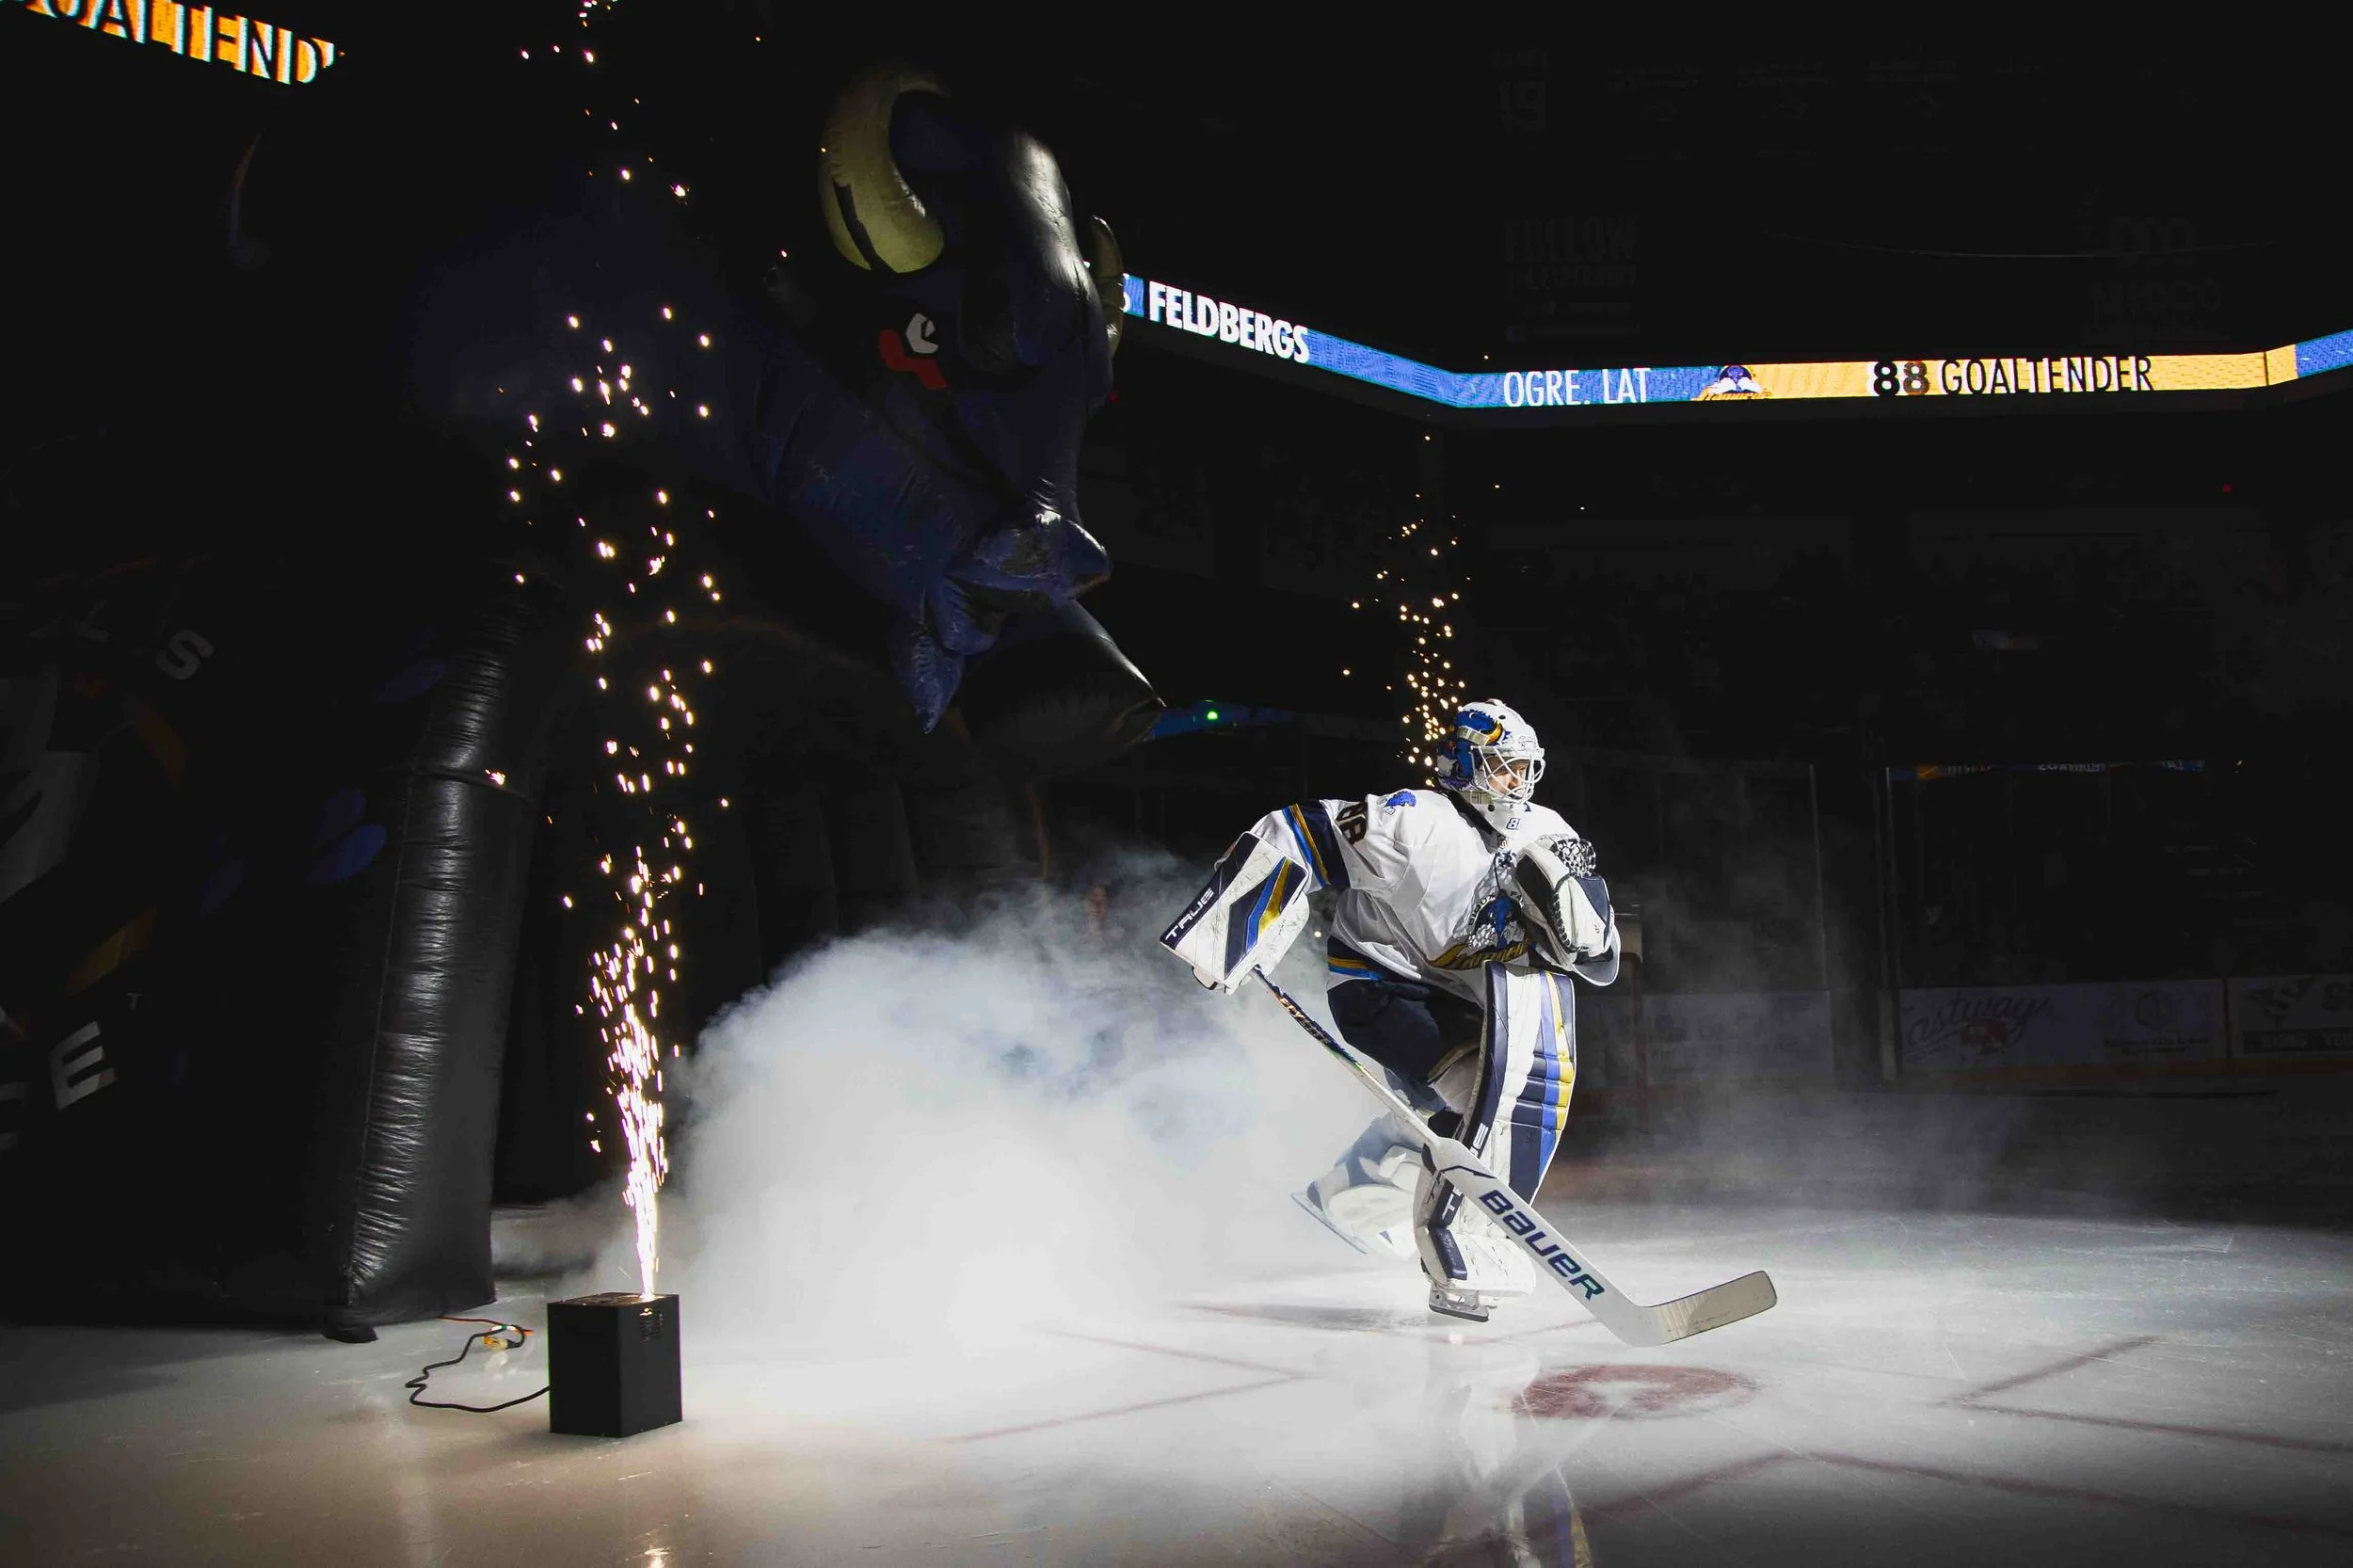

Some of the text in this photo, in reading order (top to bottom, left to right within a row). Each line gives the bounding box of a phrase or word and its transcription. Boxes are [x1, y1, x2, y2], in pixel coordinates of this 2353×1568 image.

[1149, 280, 1310, 363] FELDBERGS
[1504, 367, 1652, 407] OGRE. LAT
[1873, 357, 2153, 395] 88 GOALTENDER
[1478, 1189, 1606, 1301] BAUER
